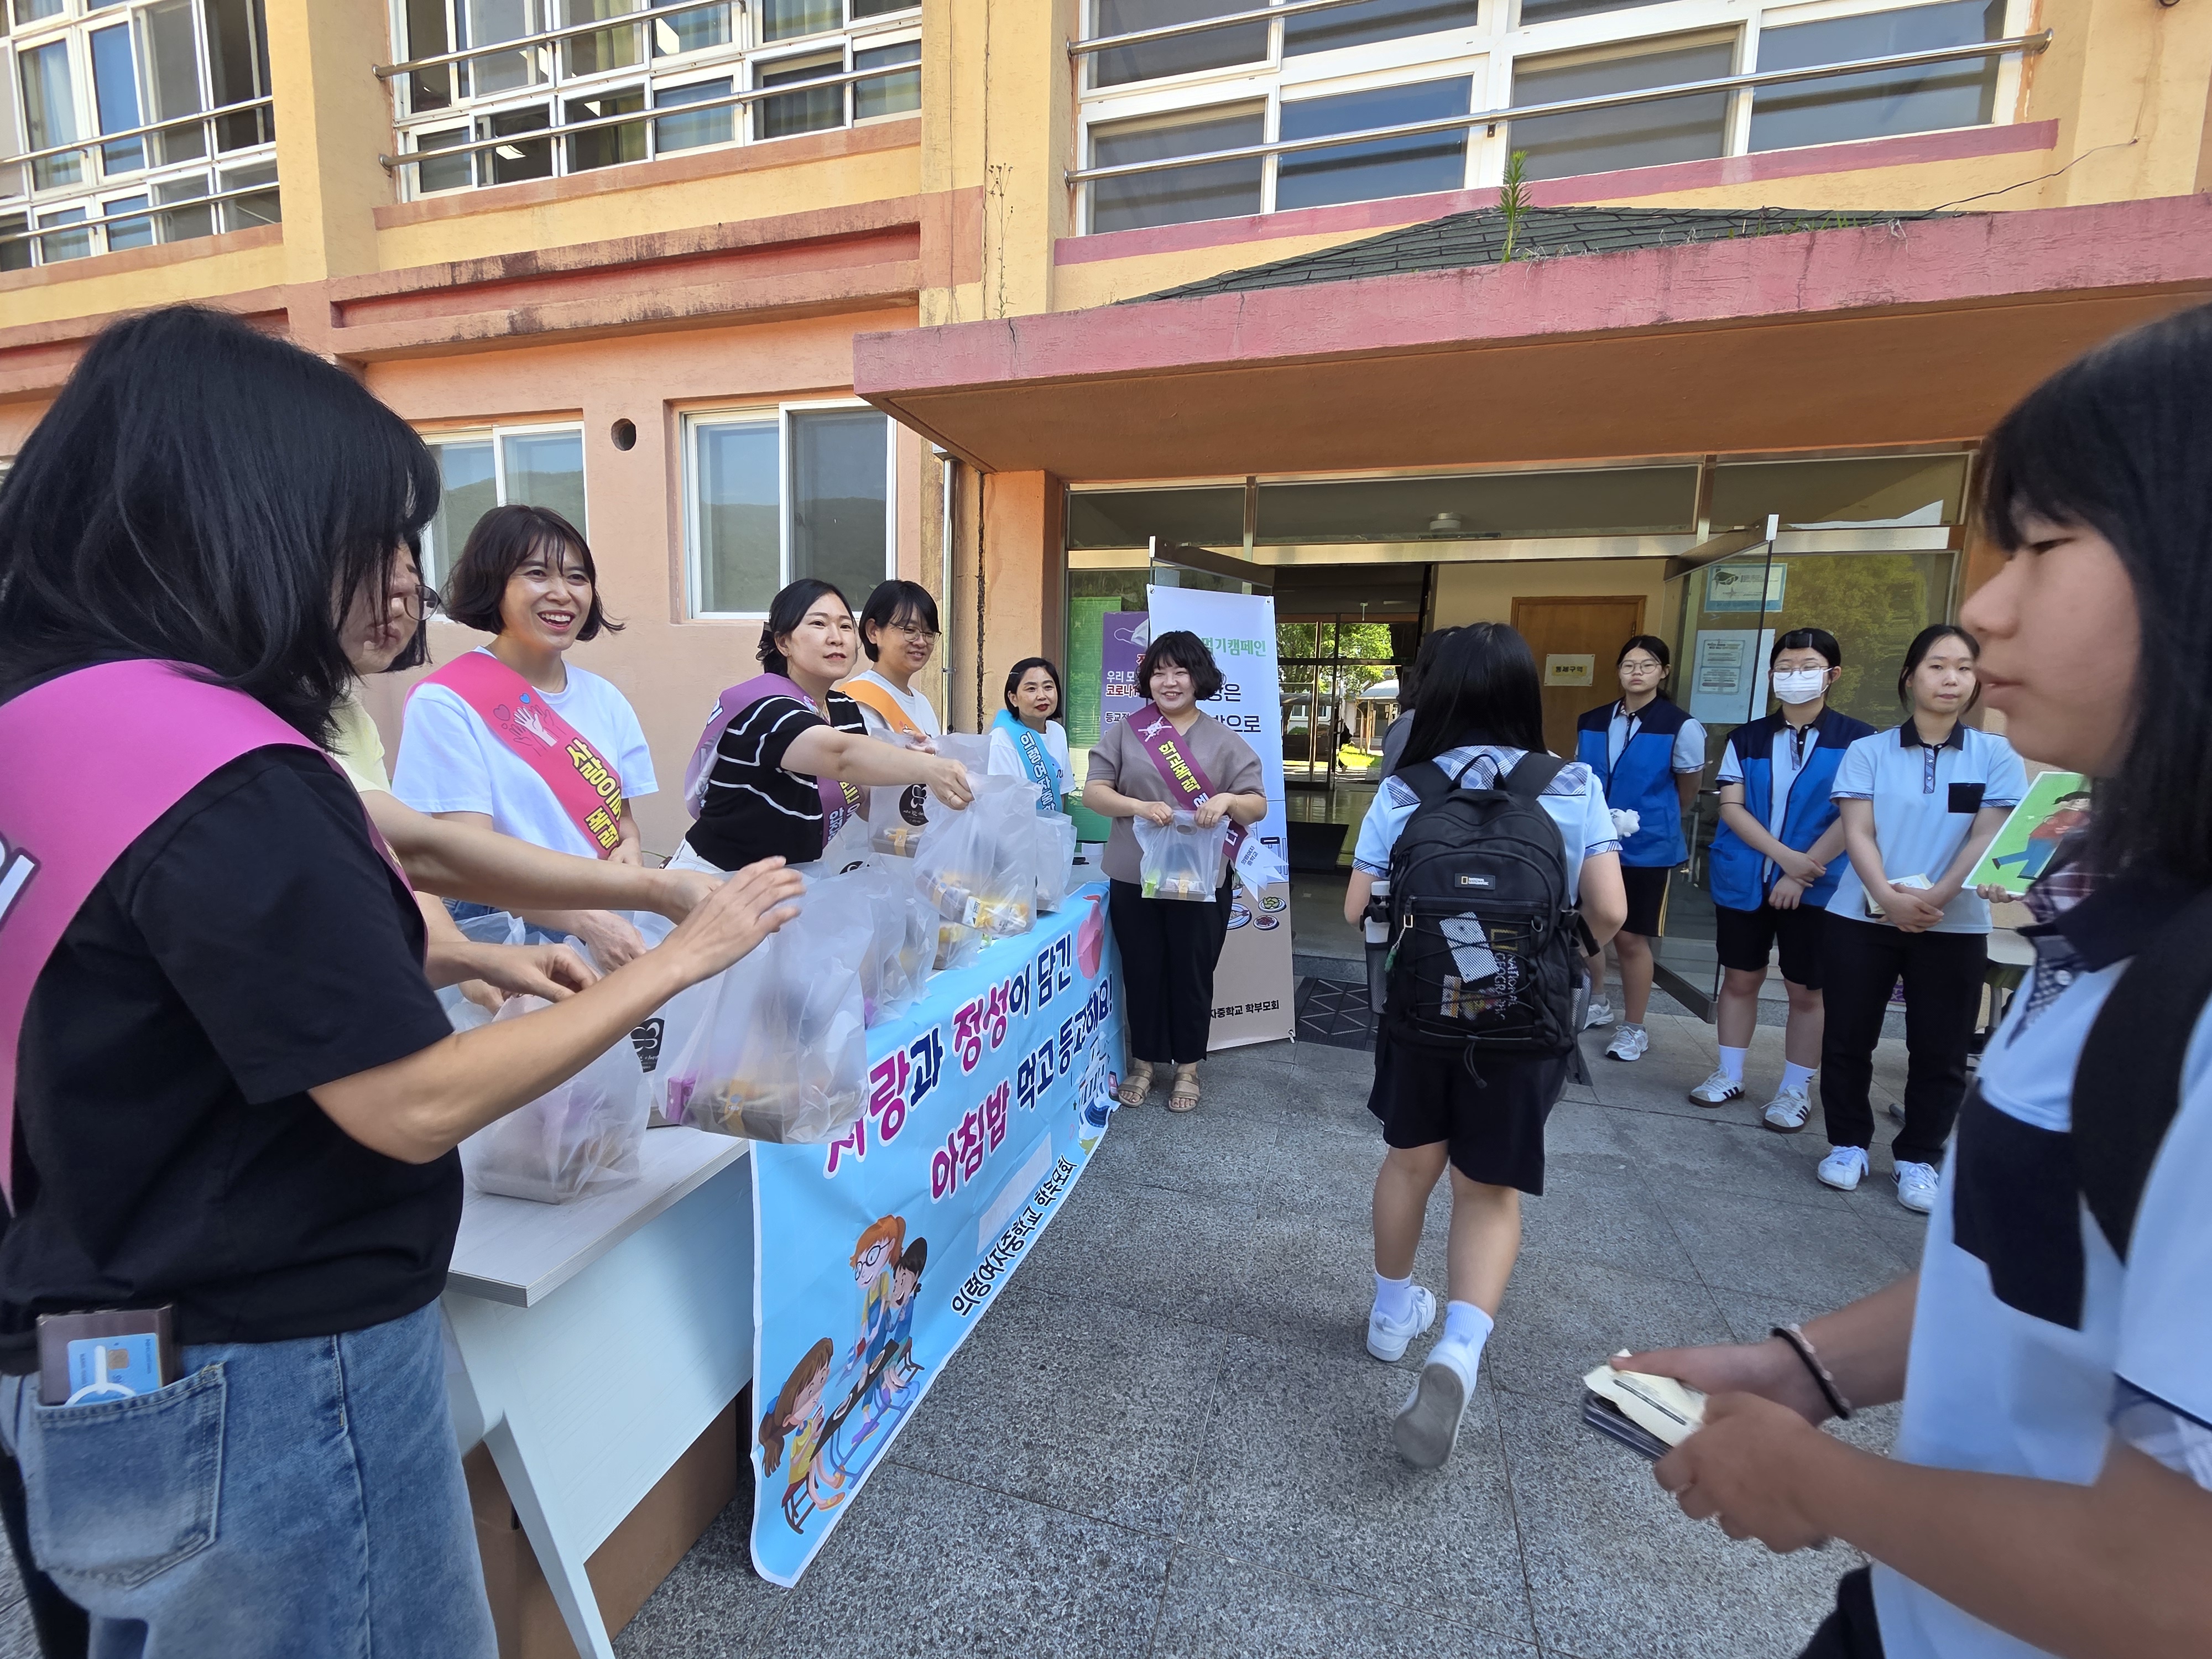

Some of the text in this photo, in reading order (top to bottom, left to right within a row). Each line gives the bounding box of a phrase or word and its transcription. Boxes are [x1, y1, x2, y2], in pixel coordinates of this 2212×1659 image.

[1106, 685, 1139, 698] 코로나1
[1107, 671, 1124, 683] 우리
[1159, 740, 1201, 793] 학교폭력
[953, 963, 1030, 1072] 정성이
[1037, 933, 1071, 1008] 담긴
[1245, 999, 1279, 1014] 학부모회
[932, 1080, 1010, 1199] 아침밥
[1018, 1040, 1055, 1109] 먹고
[952, 1154, 1078, 1316] 의령여자중학교 학부모회
